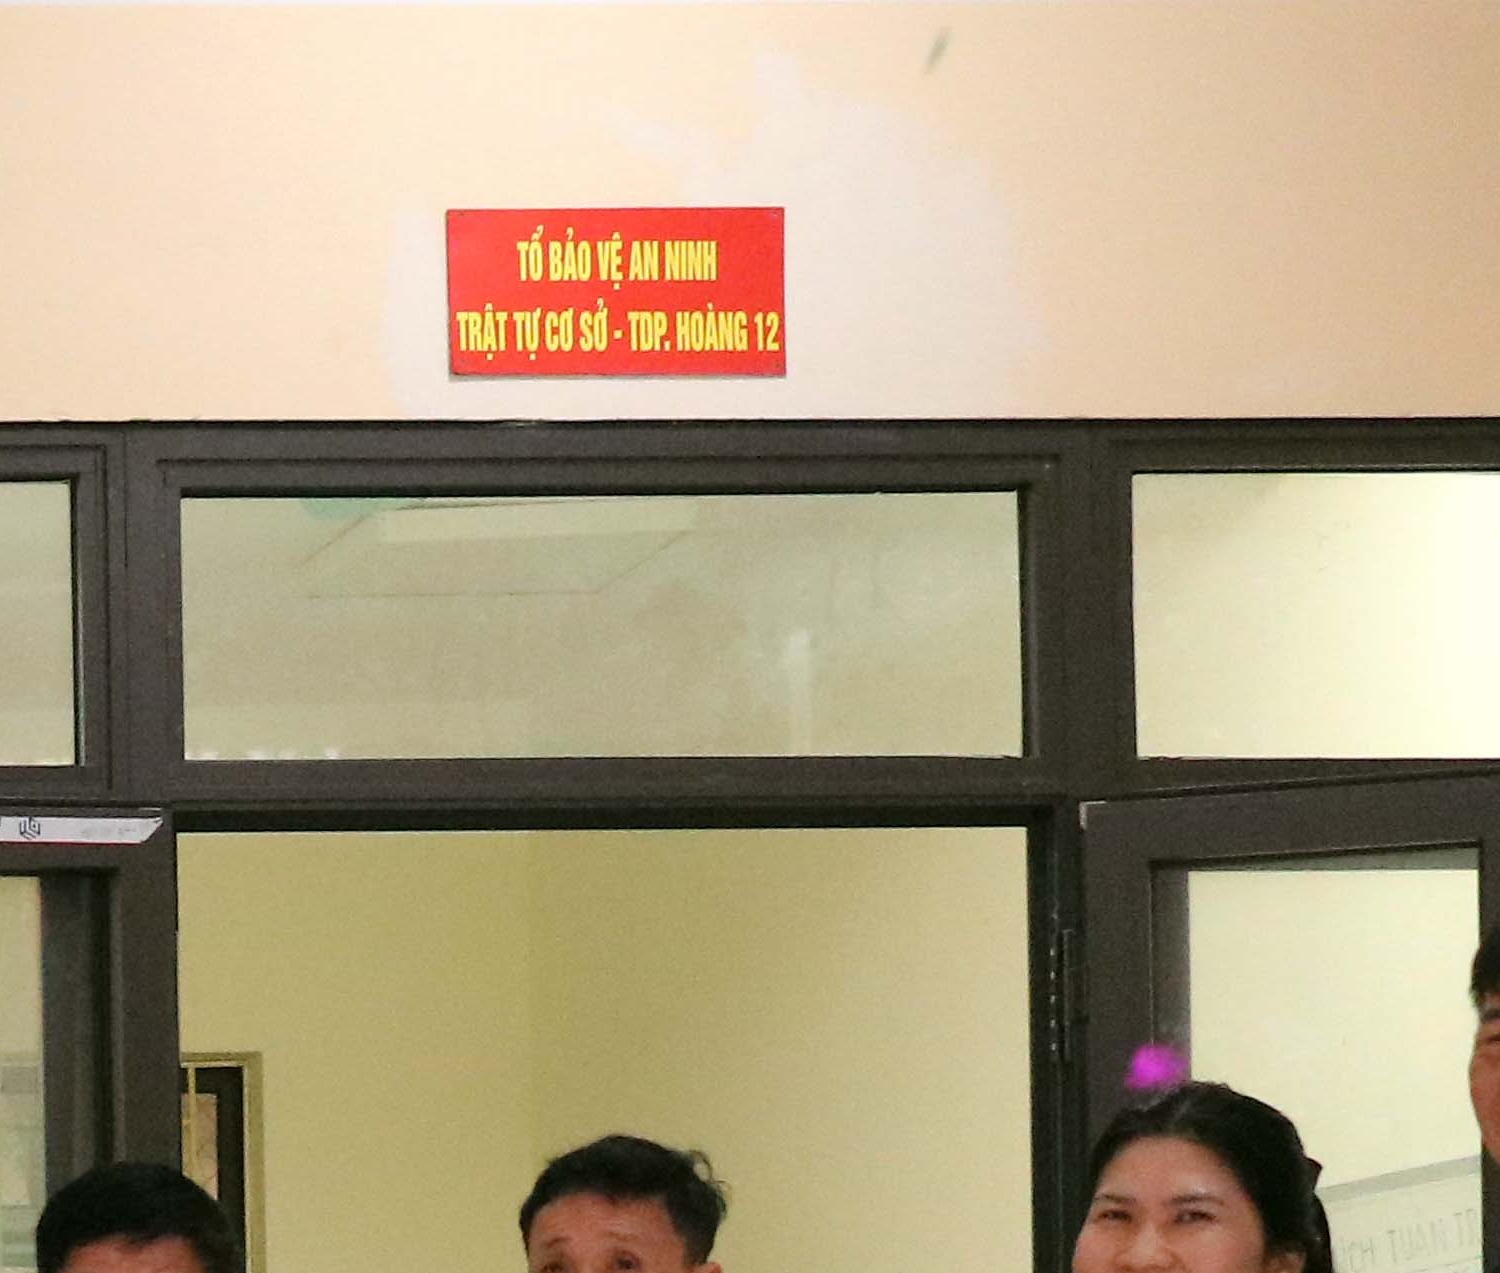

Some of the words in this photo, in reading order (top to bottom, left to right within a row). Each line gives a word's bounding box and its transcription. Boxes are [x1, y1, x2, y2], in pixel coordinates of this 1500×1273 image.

[516, 224, 544, 282] TỔ
[548, 226, 592, 282] BẢO
[596, 231, 624, 290] VỆ
[628, 239, 659, 281] AN
[664, 238, 717, 281] NINH
[456, 302, 508, 360] TRẬT
[513, 307, 542, 360] TỰ
[545, 307, 576, 352] CƠ
[579, 297, 609, 352] SỞ
[627, 310, 671, 352] TDP.
[754, 310, 780, 352] 12
